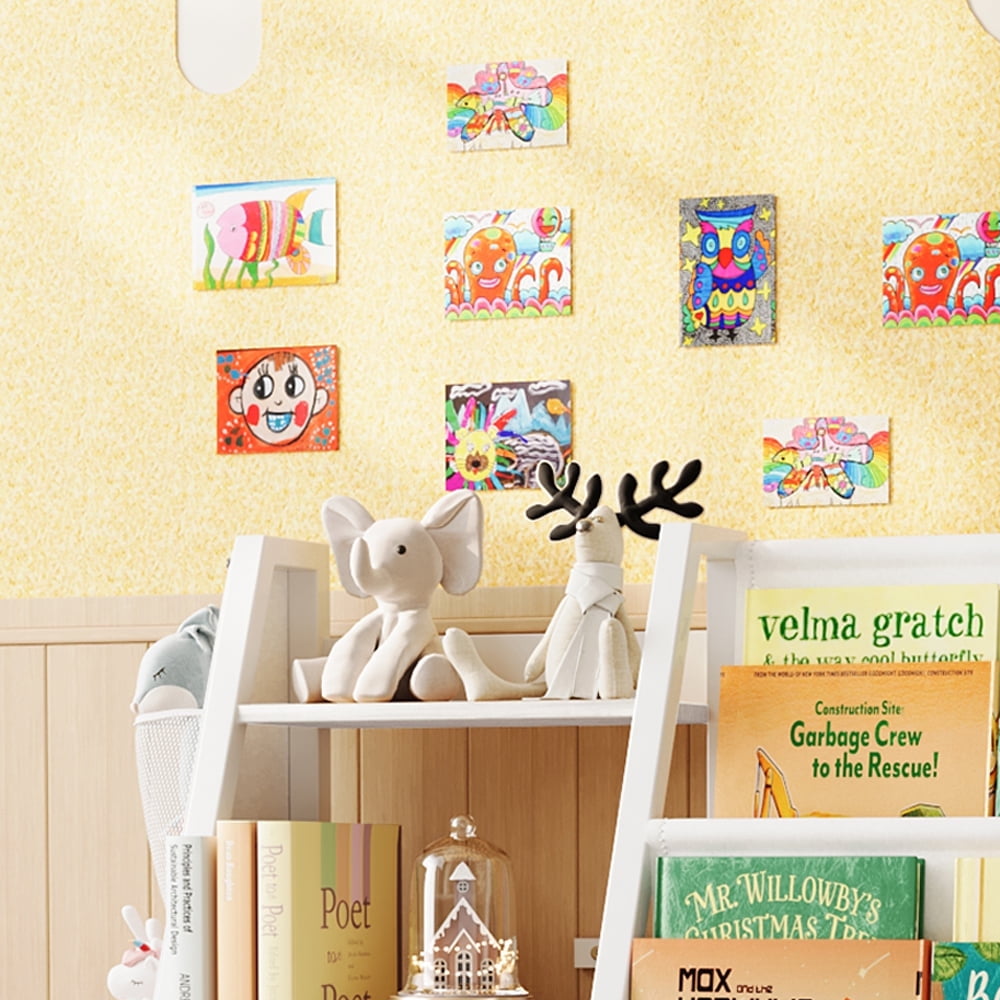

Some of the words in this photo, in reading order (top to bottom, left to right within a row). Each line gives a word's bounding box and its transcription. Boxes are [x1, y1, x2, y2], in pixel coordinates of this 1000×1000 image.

[757, 606, 862, 641] velma
[872, 602, 984, 648] gratch
[815, 700, 880, 716] Construction
[790, 720, 870, 755] Garbage
[874, 720, 923, 747] Crew
[812, 757, 830, 778] to
[834, 752, 863, 778] the
[868, 752, 939, 778] Rescue!
[182, 843, 193, 877] Principles
[182, 878, 193, 891] and
[182, 892, 193, 924] Practices
[320, 887, 372, 930] Poet
[182, 925, 193, 934] of
[825, 912, 877, 940] TR
